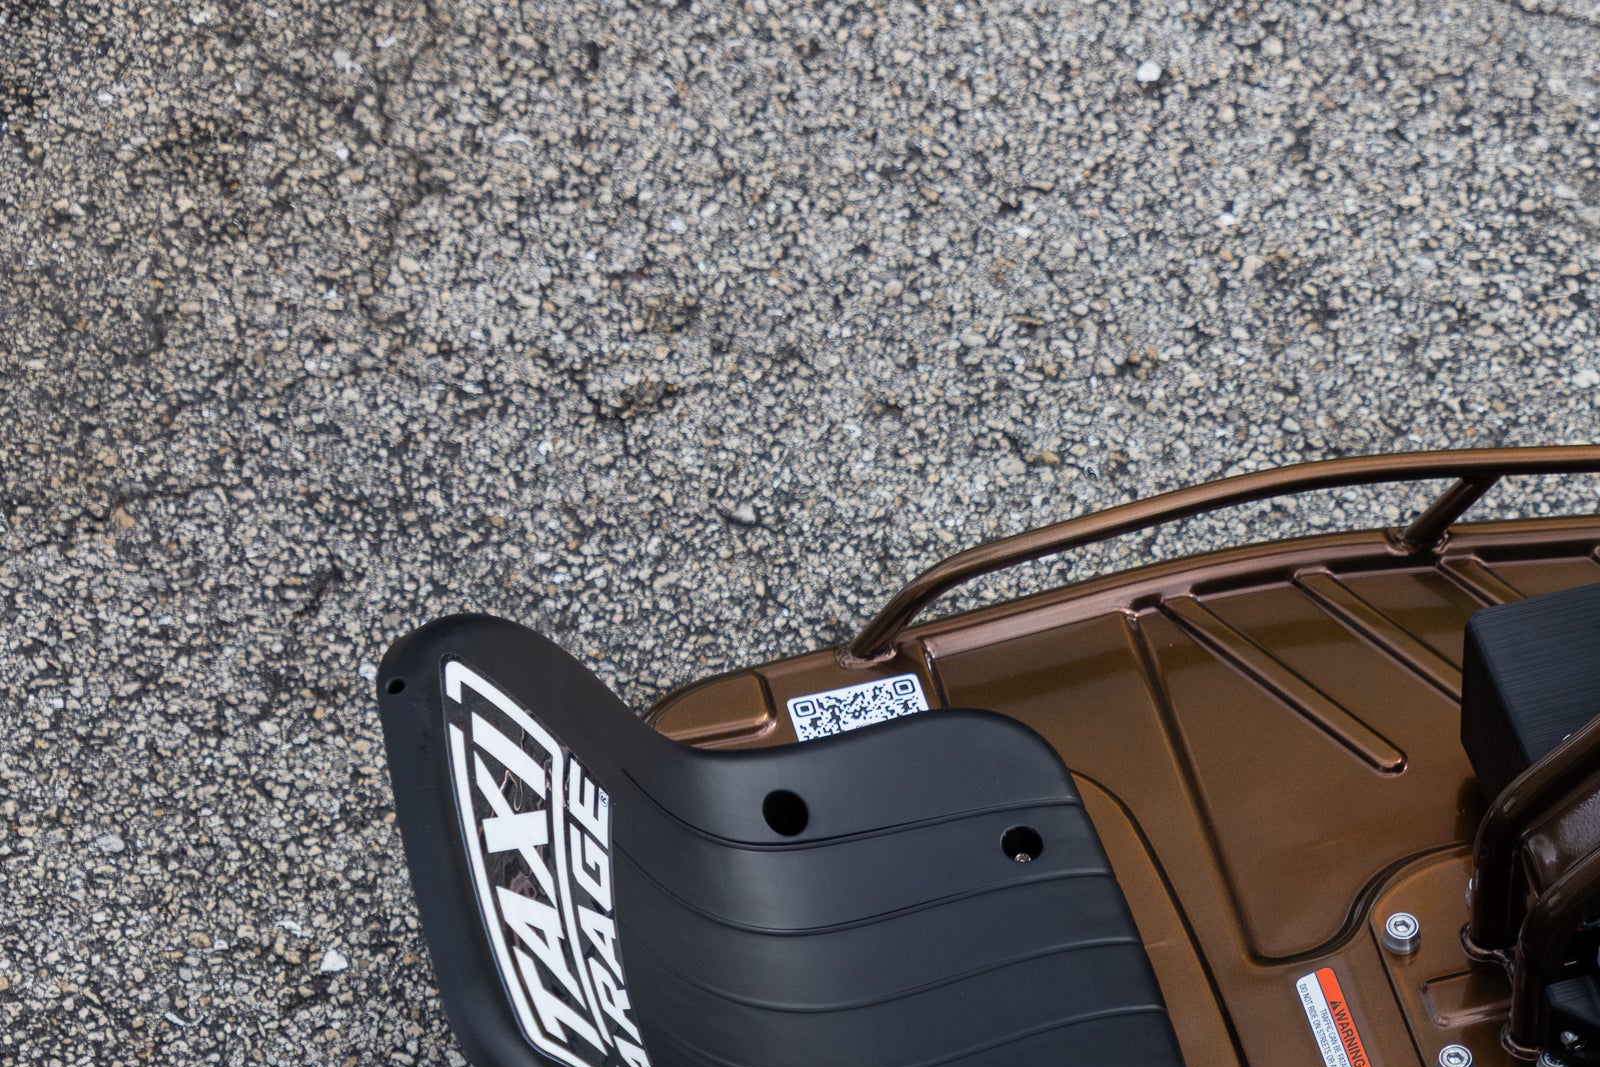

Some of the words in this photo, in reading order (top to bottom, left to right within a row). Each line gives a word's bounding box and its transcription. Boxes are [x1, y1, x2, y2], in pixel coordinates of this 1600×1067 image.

[471, 711, 608, 1056] TAXI
[1299, 983, 1308, 993] DO
[1304, 992, 1313, 1006] NOT
[1308, 1004, 1318, 1020] RIDE
[1313, 1019, 1322, 1029] ON
[1320, 1008, 1334, 1033] TRAFFIC
[1317, 1027, 1332, 1055] STREETS
[1329, 1031, 1338, 1045] CAN
[1333, 1043, 1342, 1054] BE
[1326, 1054, 1335, 1066] OR
